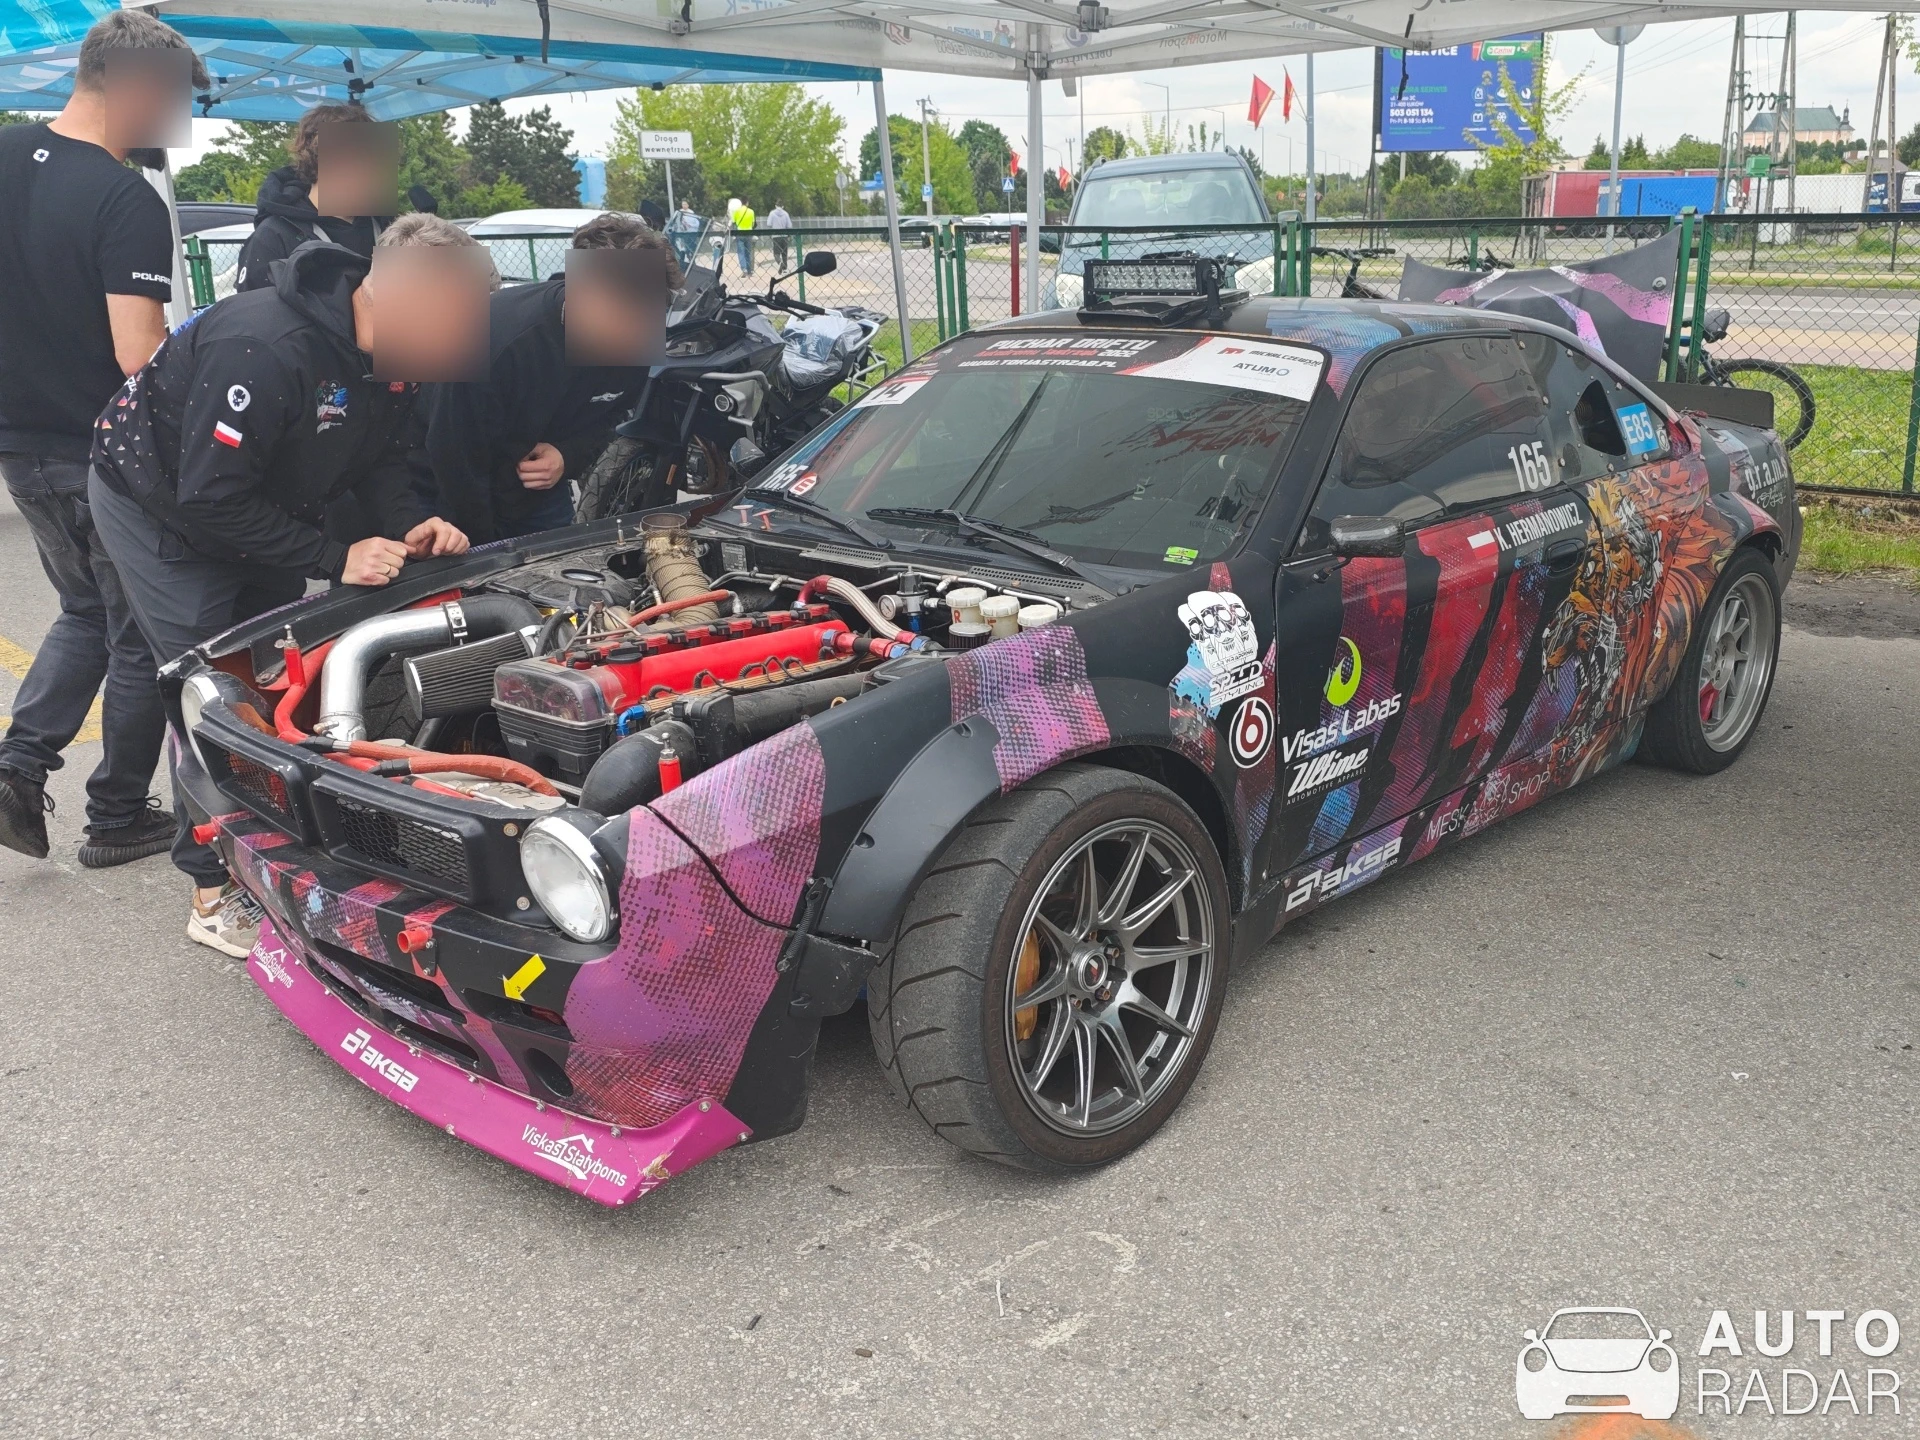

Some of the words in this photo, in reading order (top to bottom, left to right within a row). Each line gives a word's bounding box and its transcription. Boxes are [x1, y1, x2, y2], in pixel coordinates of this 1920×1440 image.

[1390, 108, 1405, 117] 503
[1405, 108, 1419, 117] 051
[1420, 108, 1434, 117] 134
[644, 146, 691, 154] wewnętrzna
[654, 134, 678, 144] Droga
[132, 271, 171, 286] POLARIS
[986, 338, 1074, 351] PUCHAR
[1070, 338, 1158, 351] DRIFTU
[1097, 349, 1139, 358] 2022
[1621, 411, 1655, 445] E85
[1507, 440, 1552, 493] 165
[1493, 527, 1513, 552] K.
[1505, 502, 1584, 547] HERMANOWICZ
[953, 609, 962, 623] R
[1208, 660, 1263, 695] SPEED
[1211, 678, 1264, 703] STYLING
[1282, 720, 1340, 764] Visas
[1343, 692, 1402, 736] Labas
[1286, 781, 1334, 806] AUTOMOTIVE
[1337, 767, 1368, 784] APPAREL
[1287, 748, 1369, 798] Ultime
[1508, 770, 1552, 805] SHOP
[521, 1123, 561, 1157] Viskas
[563, 1144, 628, 1187] Statyboms
